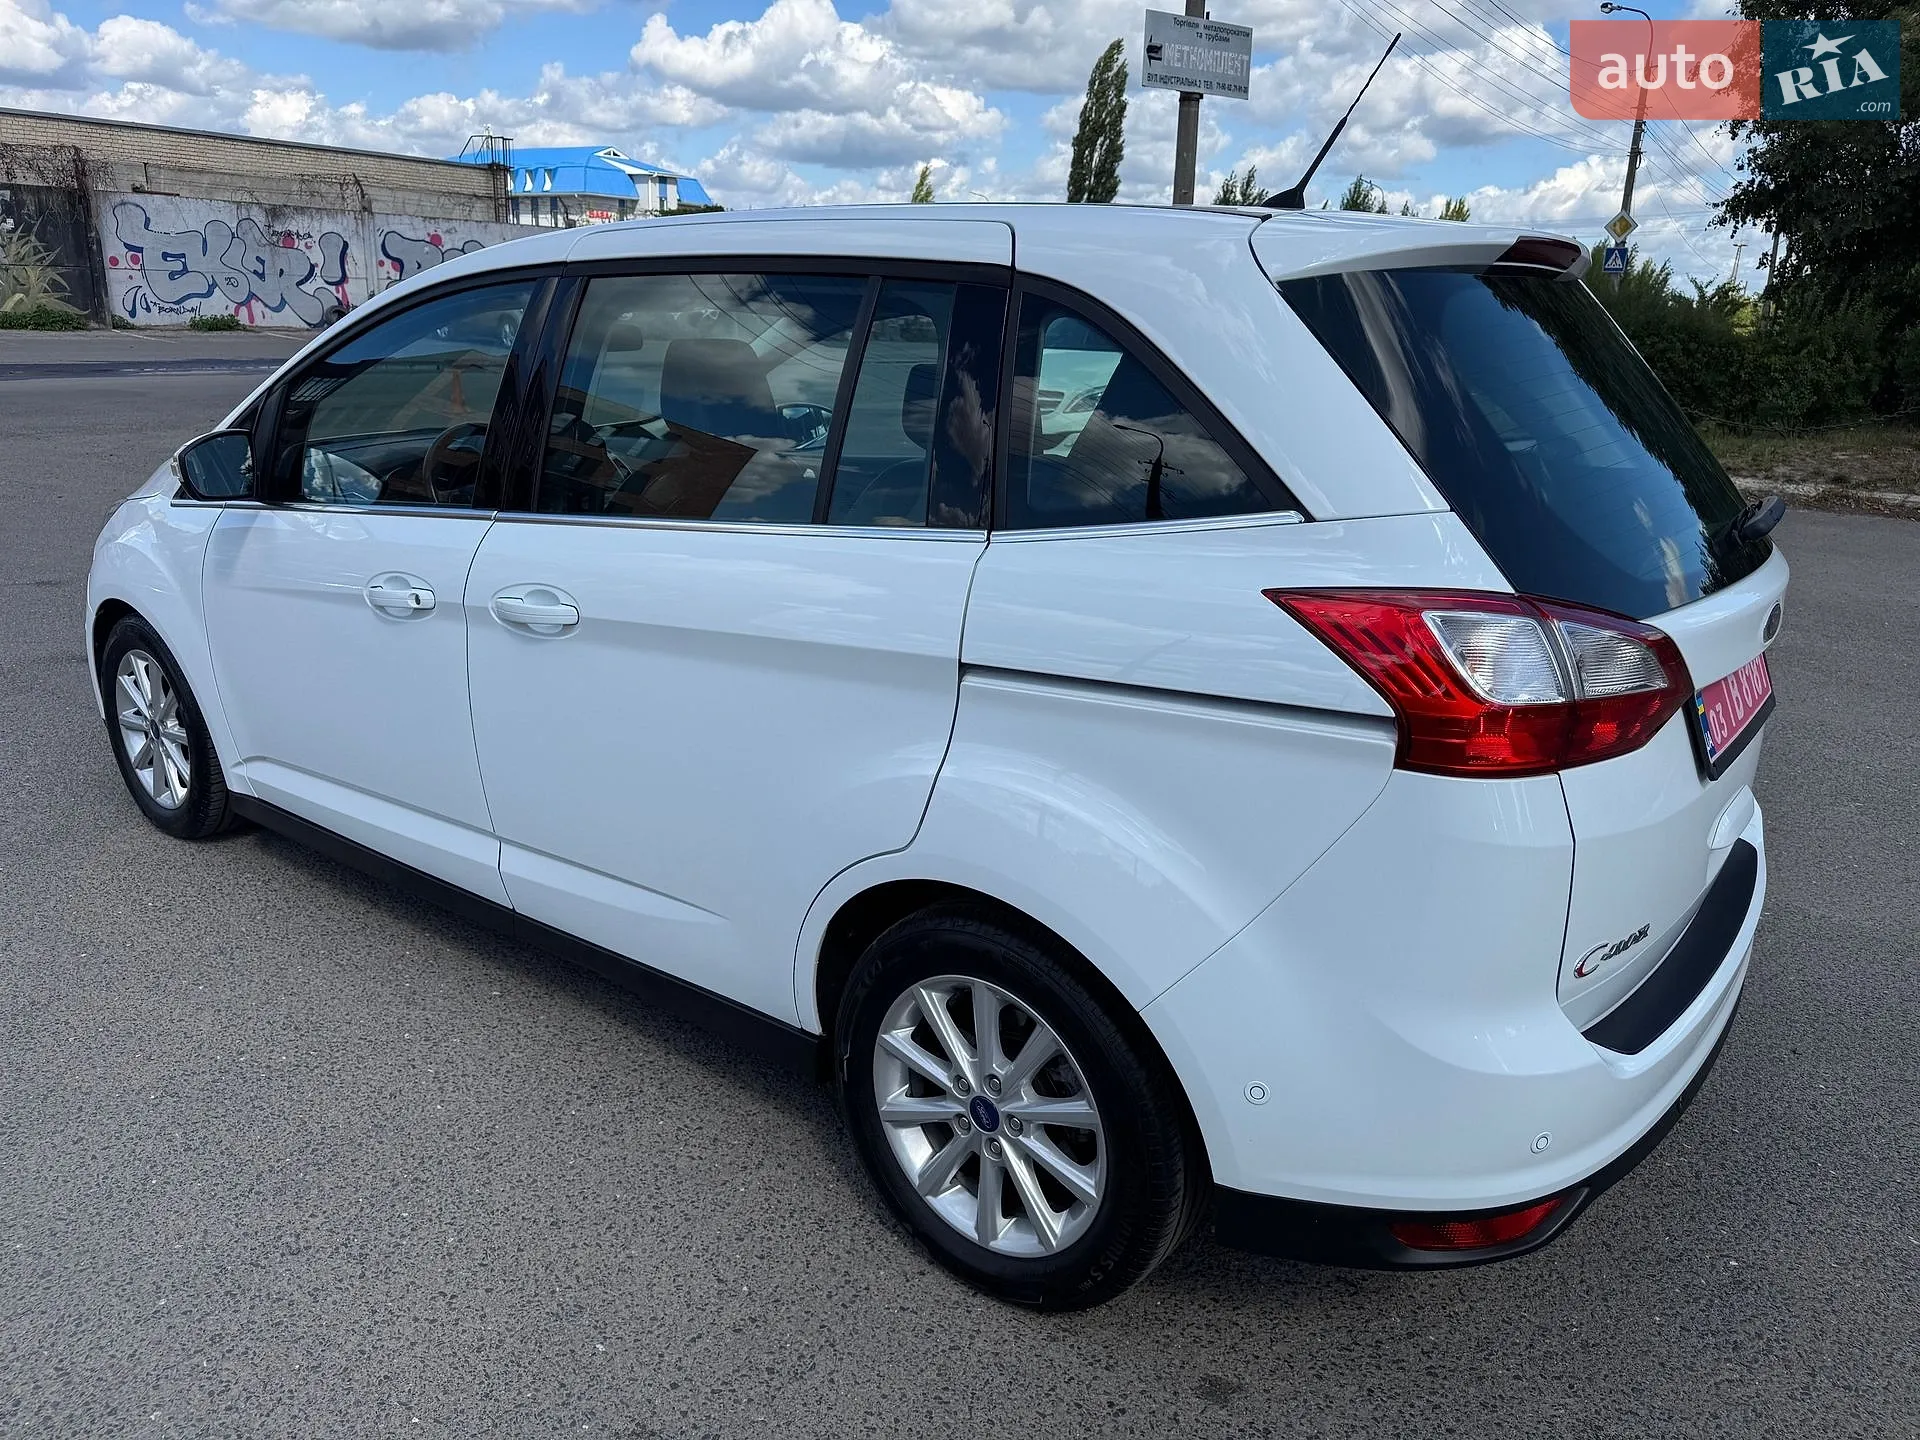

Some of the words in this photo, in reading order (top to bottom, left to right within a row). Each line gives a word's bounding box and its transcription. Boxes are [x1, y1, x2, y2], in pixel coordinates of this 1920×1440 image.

[1173, 17, 1200, 28] Торгівля
[1196, 31, 1203, 39] та
[1205, 33, 1231, 43] трубами
[1709, 702, 1728, 745] 03
